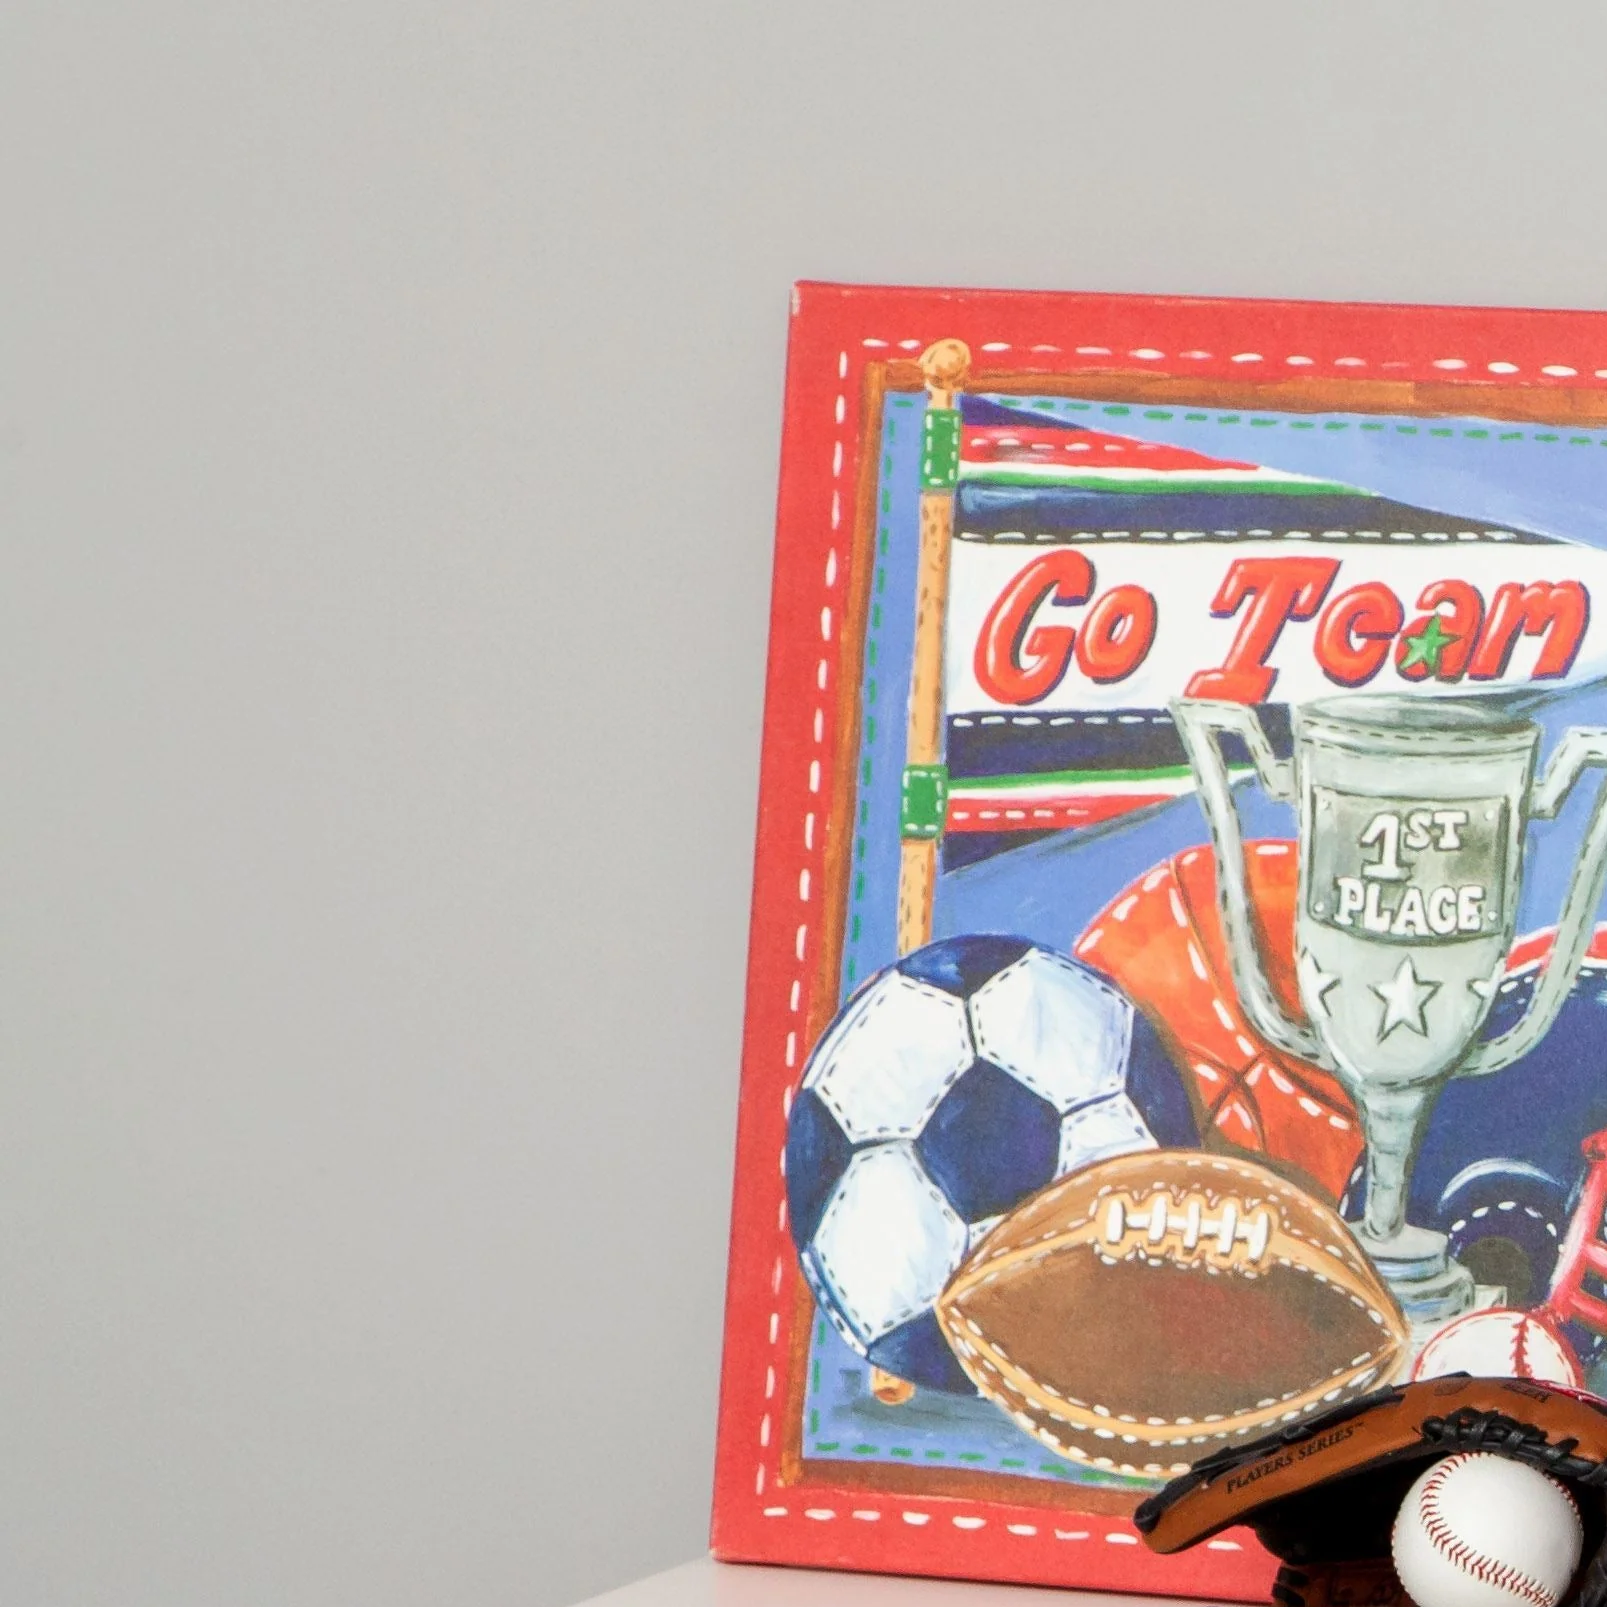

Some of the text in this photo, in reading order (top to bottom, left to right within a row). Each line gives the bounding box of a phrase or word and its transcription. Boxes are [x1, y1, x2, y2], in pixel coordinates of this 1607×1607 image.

[974, 549, 1591, 706] Go Team
[1358, 808, 1468, 881] 1ST
[1333, 878, 1486, 937] PLACE
[1226, 1454, 1294, 1494] PLAYERS
